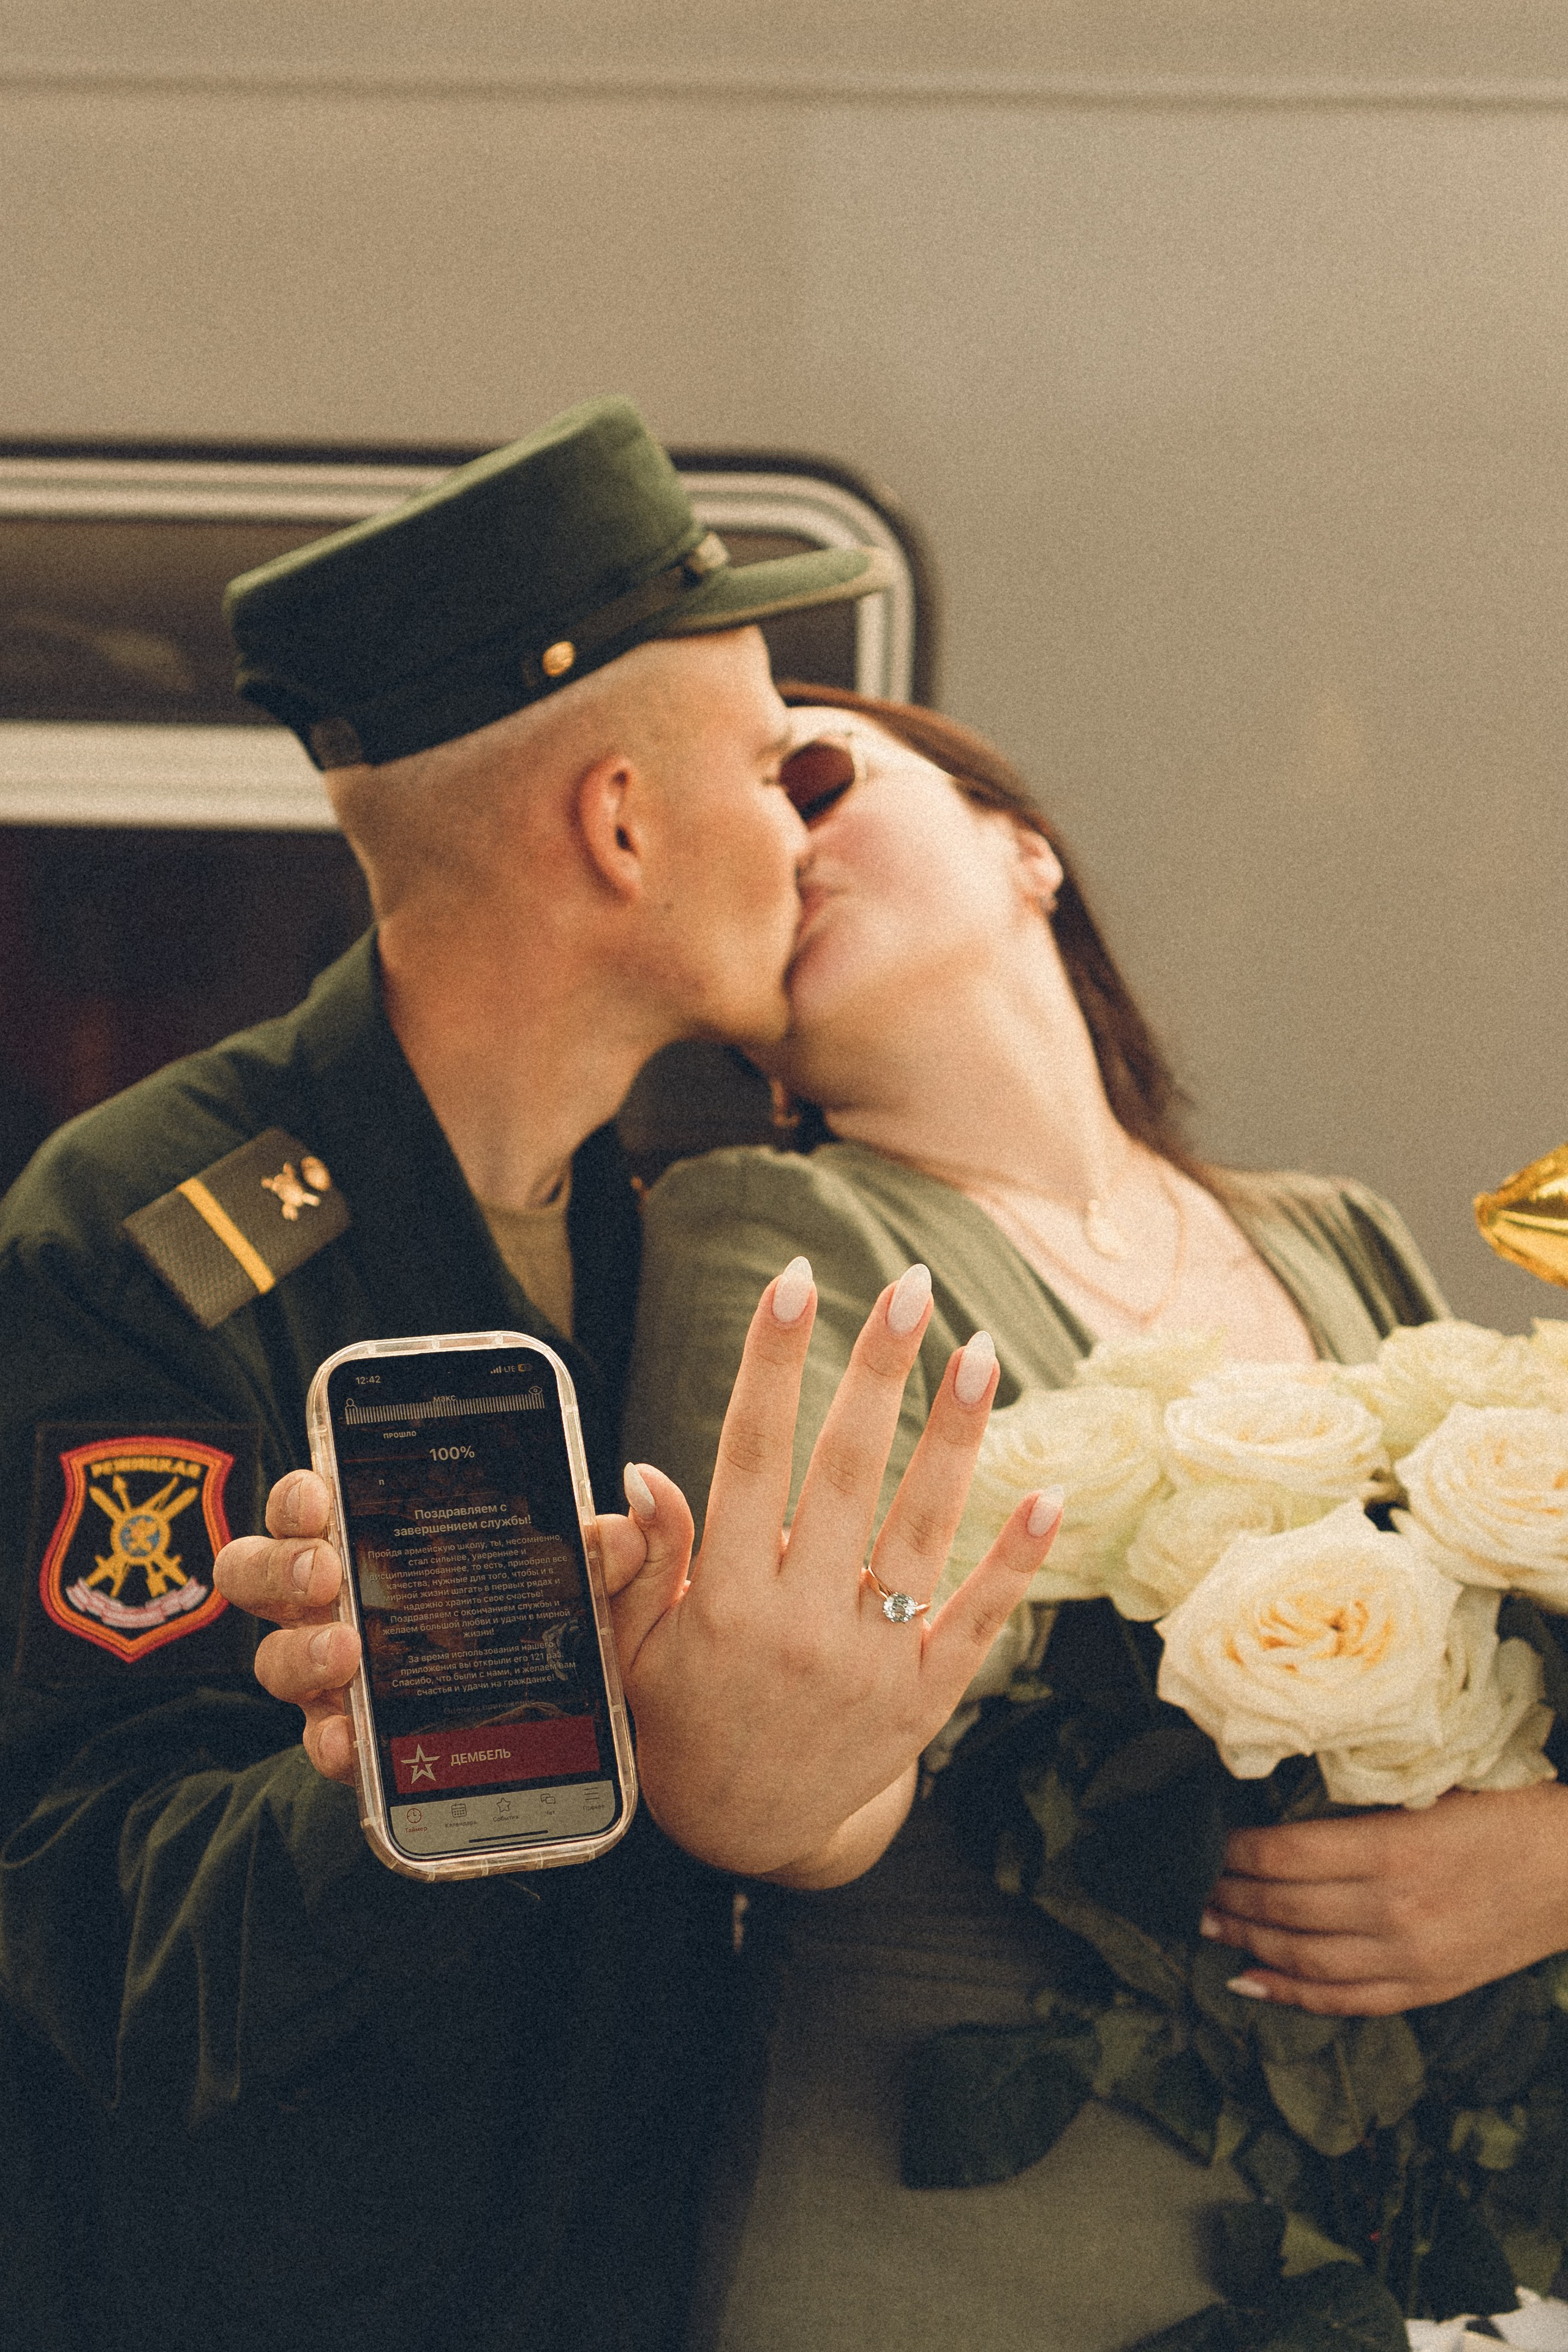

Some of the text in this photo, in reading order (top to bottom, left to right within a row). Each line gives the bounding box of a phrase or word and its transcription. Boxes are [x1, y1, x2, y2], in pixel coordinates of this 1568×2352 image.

[355, 1375, 380, 1384] 12:42
[429, 1446, 475, 1460] 100%
[414, 1505, 497, 1519] Поздравляем
[394, 1514, 531, 1536] завершением службы!
[368, 1548, 402, 1559] Пройдя
[404, 1544, 455, 1555] армейскую
[505, 1534, 562, 1545] несомненно,
[430, 1555, 469, 1563] сильнее,
[471, 1549, 518, 1561] увереннее
[369, 1566, 468, 1580] дисциплинированнее,
[507, 1557, 550, 1567] приобрел
[386, 1580, 429, 1589] качества,
[432, 1577, 467, 1586] нужные
[511, 1568, 538, 1577] чтобы
[420, 1589, 449, 1597] жизни
[491, 1581, 524, 1591] первых
[526, 1579, 552, 1588] рядах
[403, 1601, 443, 1610] надежно
[445, 1597, 481, 1607] хранить
[506, 1589, 543, 1600] счастье!
[382, 1626, 418, 1635] желаем
[420, 1619, 459, 1631] большой
[462, 1618, 491, 1626] любви
[500, 1615, 526, 1624] удачи
[536, 1608, 570, 1619] мирной
[390, 1611, 451, 1623] Поздравляем
[461, 1605, 515, 1616] окончанием
[517, 1600, 552, 1610] службы
[463, 1627, 494, 1637] жизни!
[421, 1653, 449, 1662] время
[451, 1645, 519, 1657] использования
[521, 1642, 554, 1650] нашего
[400, 1663, 456, 1675] приложения
[473, 1657, 511, 1667] открыли
[546, 1651, 564, 1660] раз.
[391, 1676, 433, 1687] Спасибо,
[522, 1664, 557, 1673] желаем
[417, 1686, 452, 1695] счастья
[462, 1683, 489, 1692] удачи
[503, 1674, 554, 1687] гражданке!
[451, 1749, 510, 1766] ДЕМБЕЛЬ
